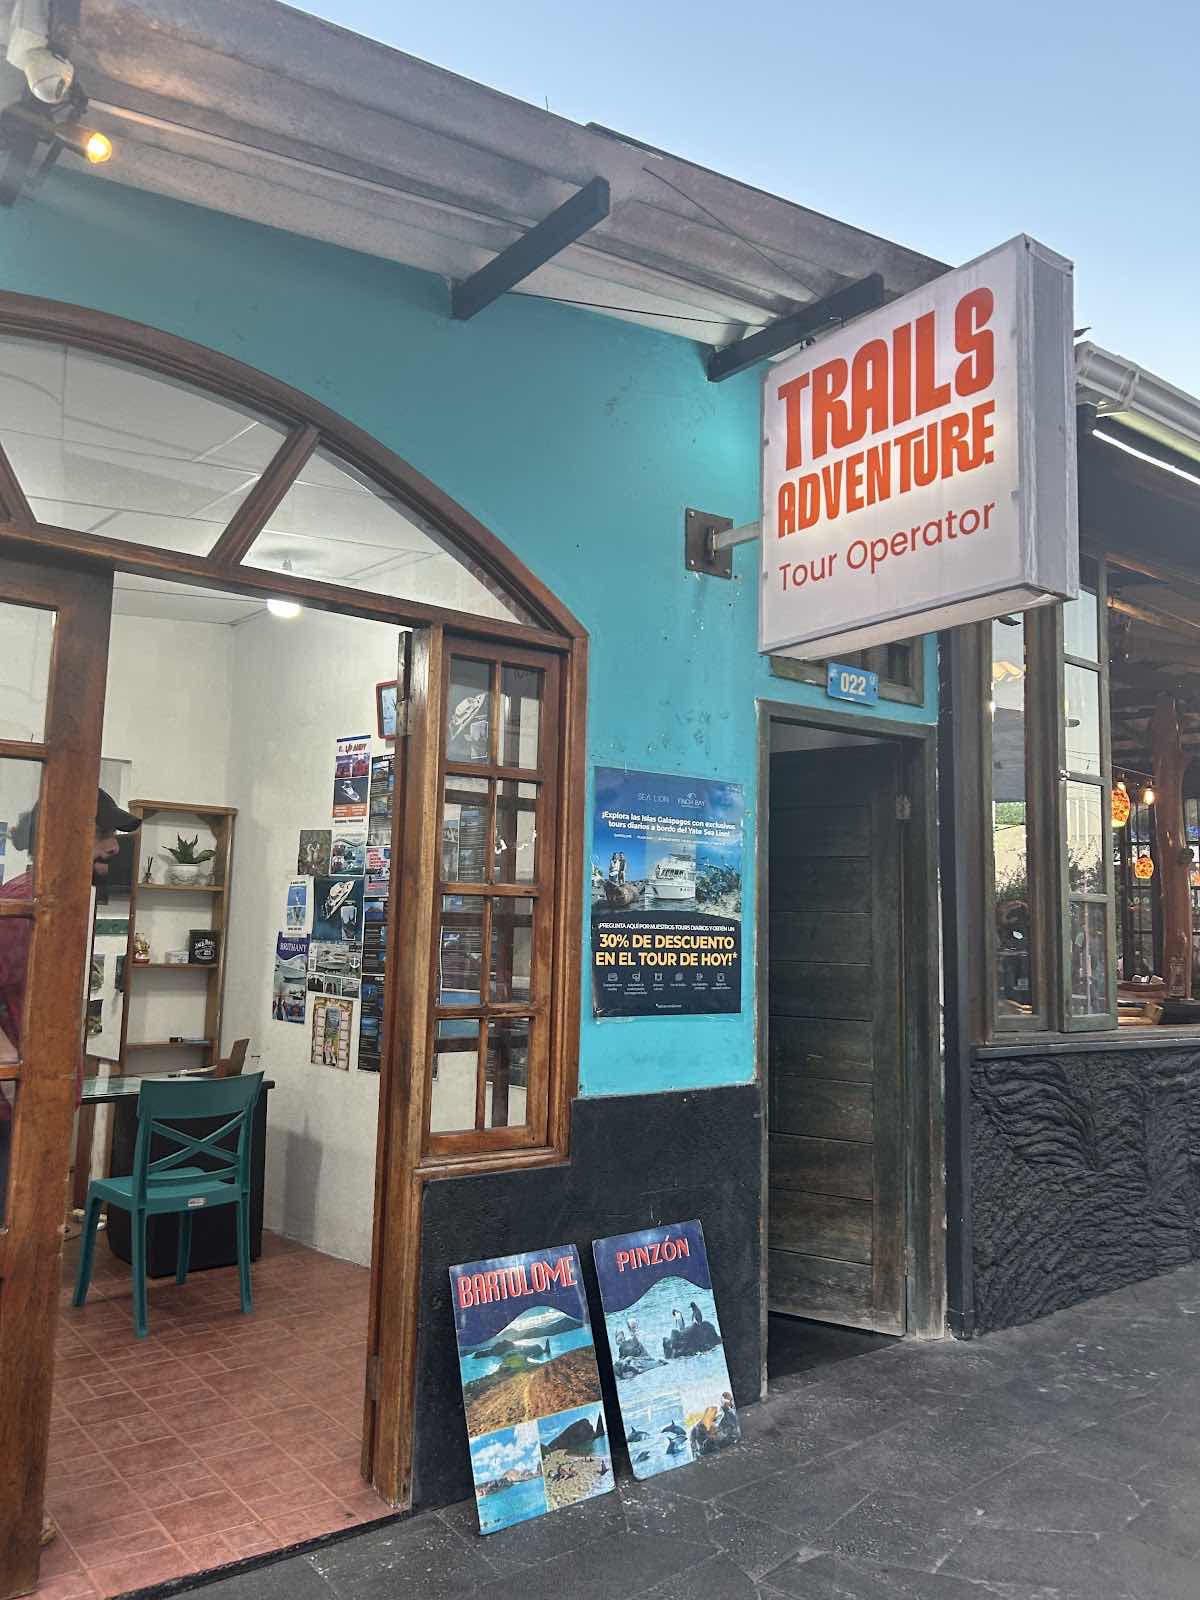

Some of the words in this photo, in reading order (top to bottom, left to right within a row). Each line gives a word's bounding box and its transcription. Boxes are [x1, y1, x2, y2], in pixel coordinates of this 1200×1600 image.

[778, 287, 994, 471] TRAILS
[778, 399, 995, 538] ADVENTURE
[779, 553, 837, 591] Tour
[847, 502, 995, 574] Operator
[840, 672, 866, 696] 022
[627, 822, 650, 830] diarios
[656, 824, 676, 833] bordo
[595, 952, 616, 966] EN
[618, 952, 637, 966] EL
[638, 952, 677, 966] TOUR
[680, 952, 699, 966] DE
[599, 933, 630, 948] 30%
[632, 934, 652, 948] DE
[655, 935, 735, 949] DESCUENTO
[616, 1234, 690, 1273] PINZÓN
[457, 1255, 578, 1309] BARTOLOME
